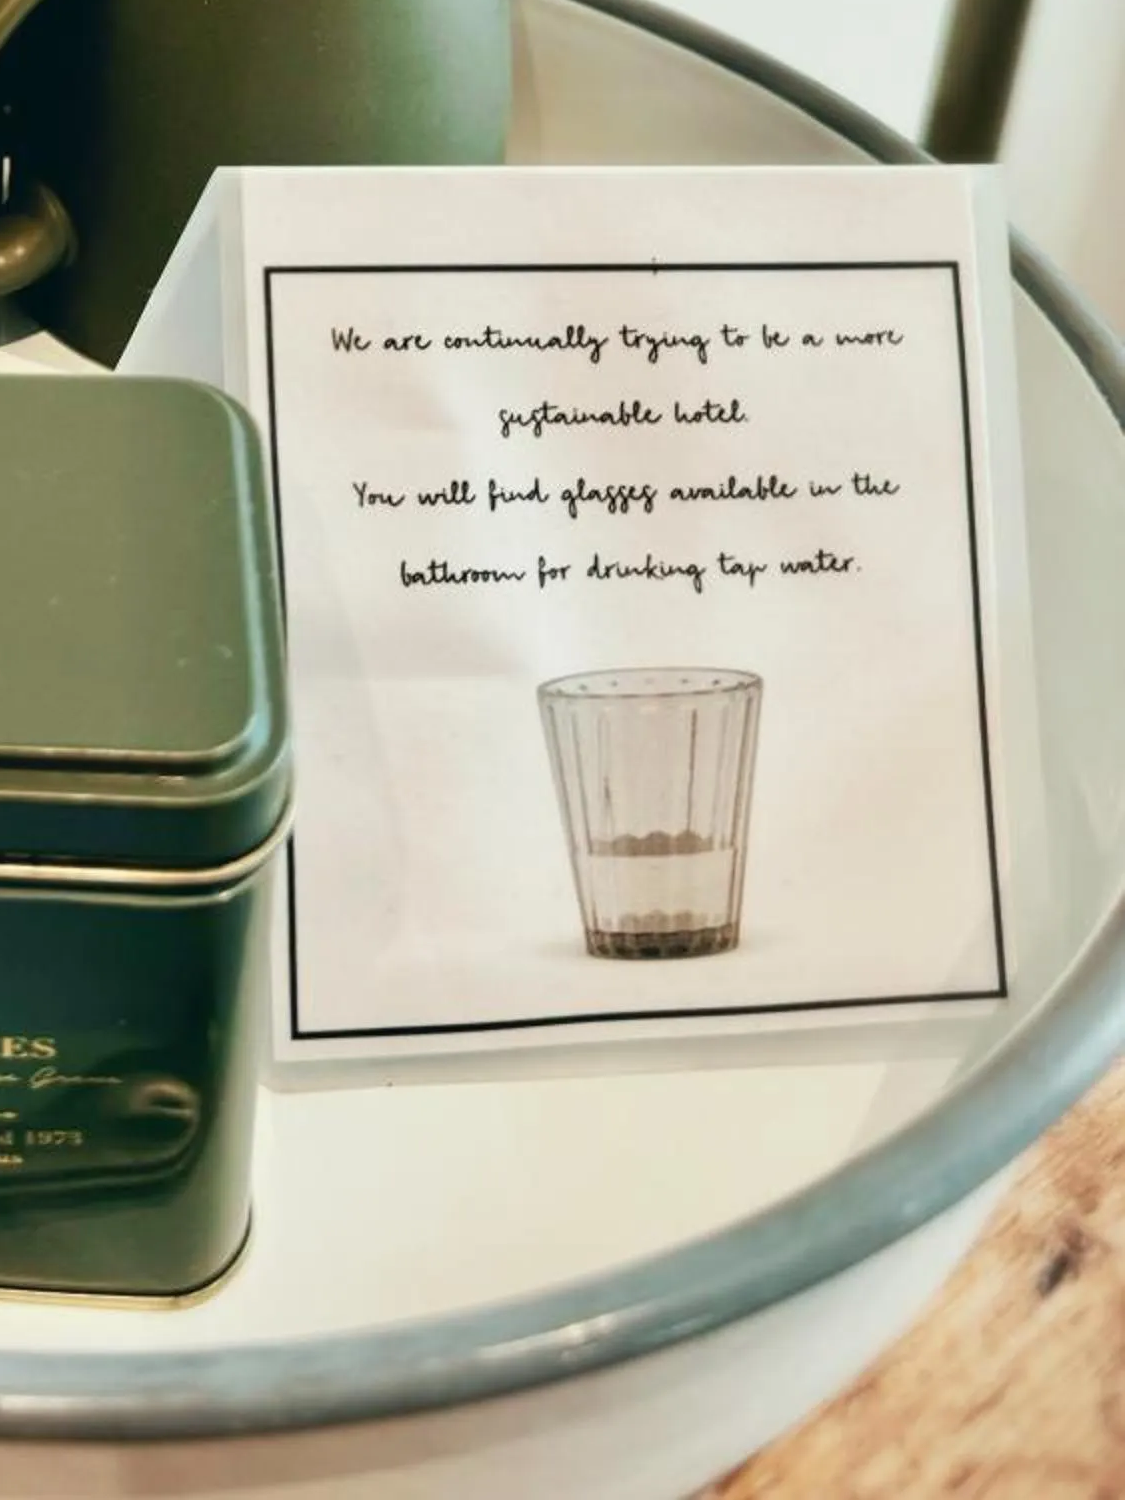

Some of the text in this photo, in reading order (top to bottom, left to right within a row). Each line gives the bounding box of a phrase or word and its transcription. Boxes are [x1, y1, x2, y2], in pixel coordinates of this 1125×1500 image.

[331, 324, 904, 364] We are continually trying to be a more
[498, 398, 751, 438] sustainable hotel.
[353, 473, 900, 519] You will find glasses available in the
[400, 548, 863, 594] bathroom for drinking tap water.
